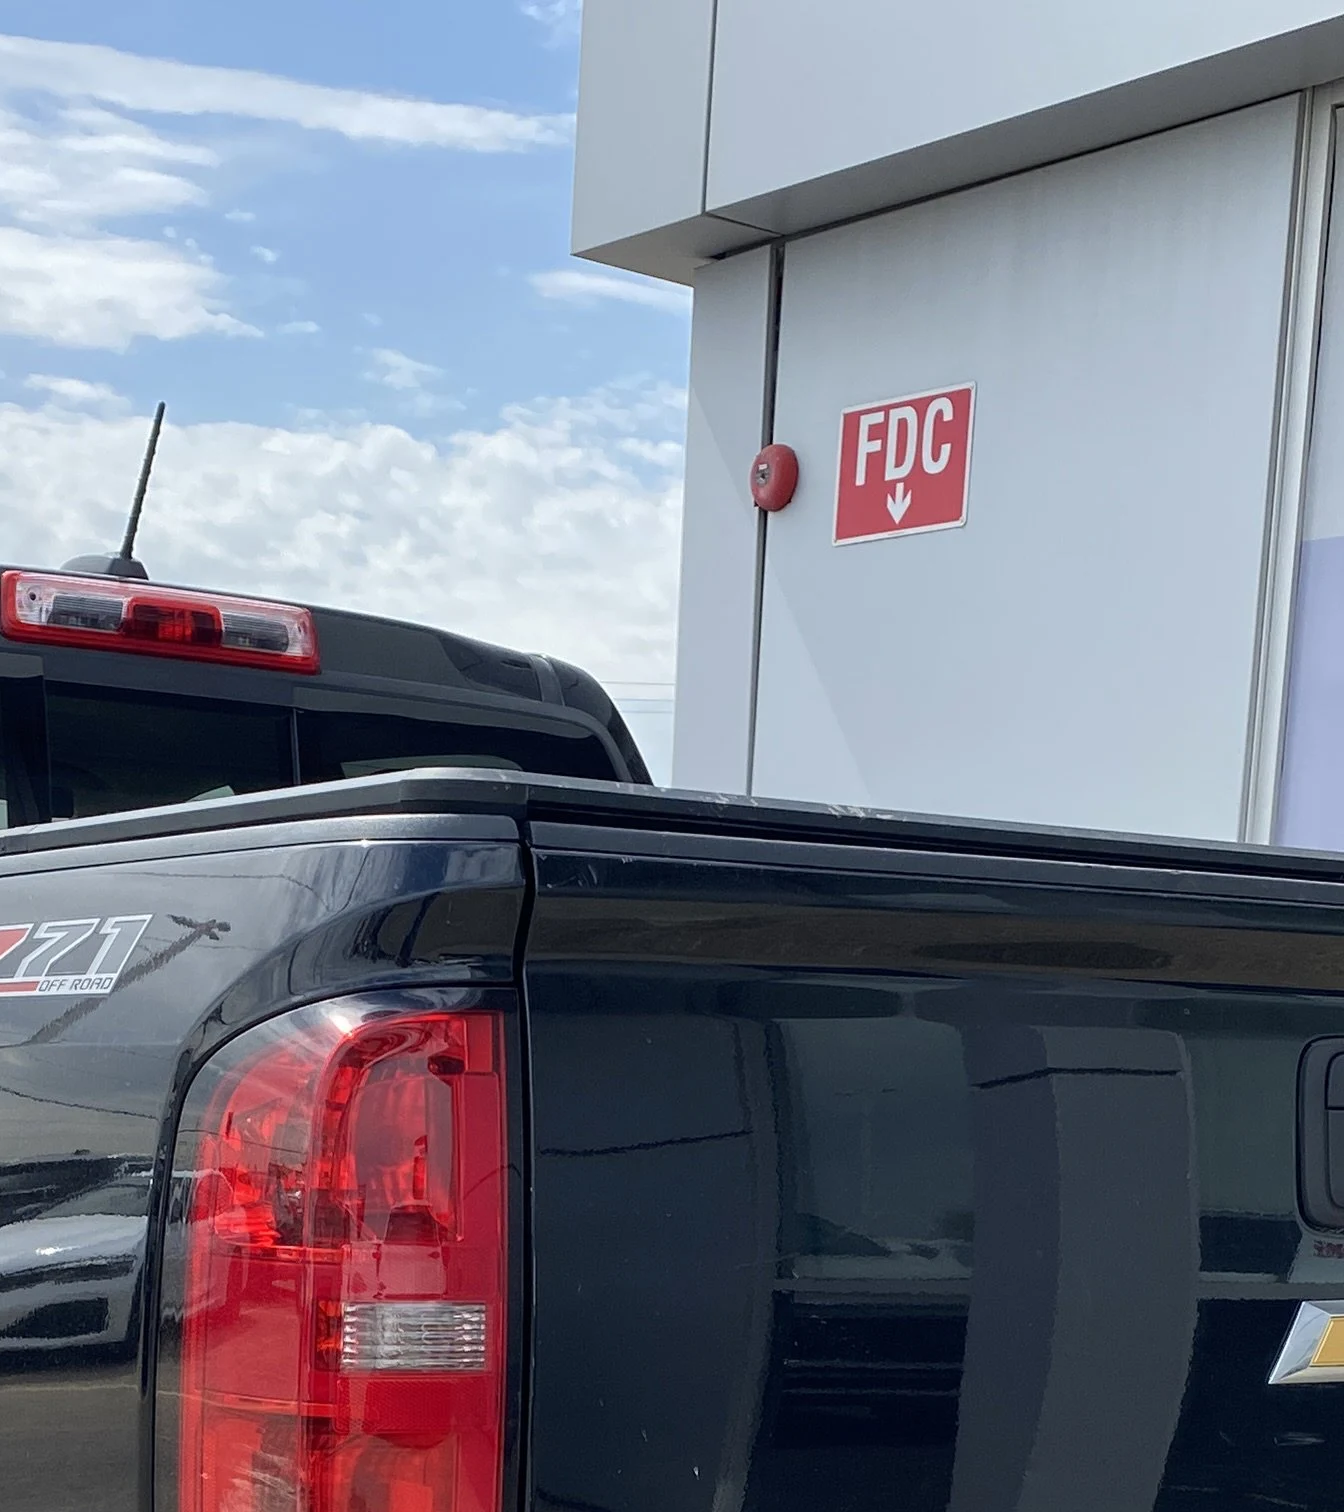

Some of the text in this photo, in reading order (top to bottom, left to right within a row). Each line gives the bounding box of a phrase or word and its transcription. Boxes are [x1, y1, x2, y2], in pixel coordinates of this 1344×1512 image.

[855, 396, 954, 487] FDC
[38, 976, 114, 992] OFF ROAD
